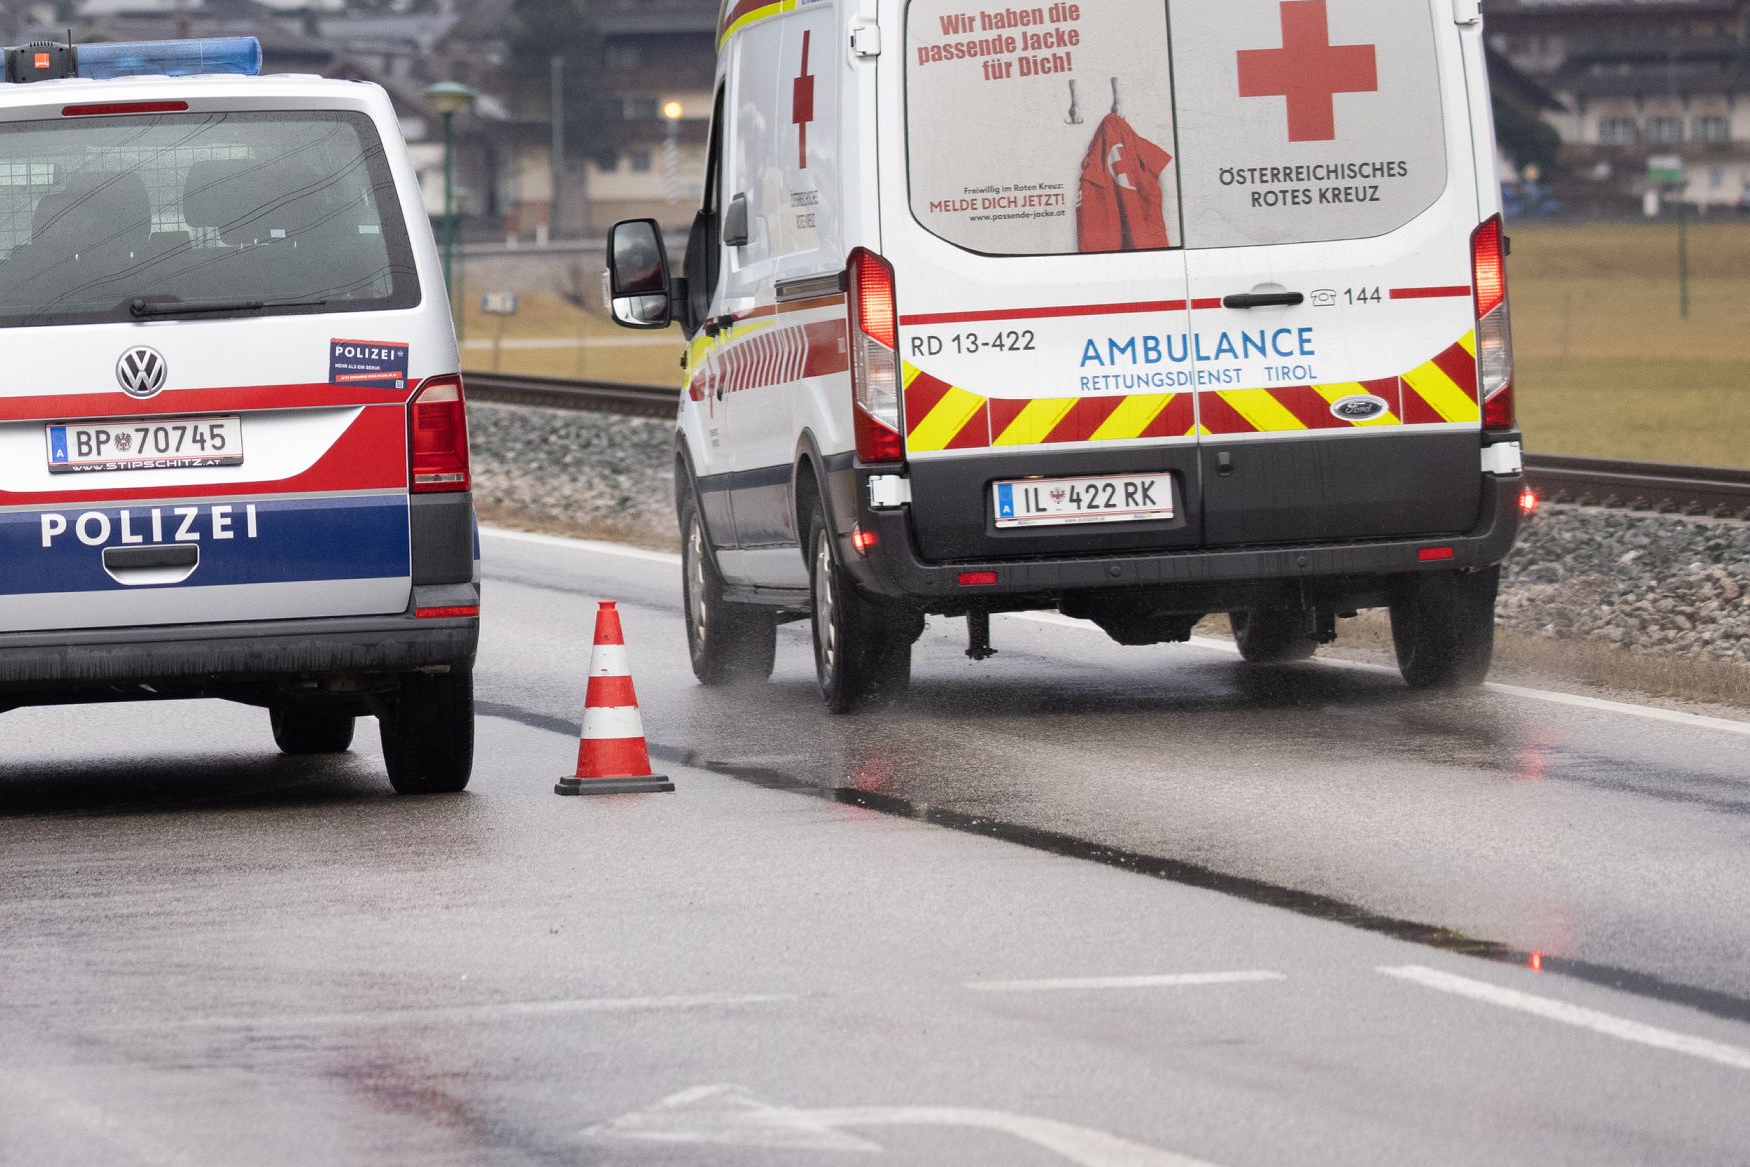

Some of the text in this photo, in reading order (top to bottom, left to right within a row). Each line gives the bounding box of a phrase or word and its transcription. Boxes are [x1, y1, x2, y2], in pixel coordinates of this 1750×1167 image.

[939, 1, 1081, 36] Wir haben die
[917, 27, 1080, 66] passende Jacke
[982, 51, 1073, 81] für Dich!
[1219, 160, 1408, 186] ÖSTERREICHISCHES
[964, 182, 1064, 195] Freiwillig im Roten Kreuz:
[1251, 185, 1380, 207] ROTES KREUZ
[930, 193, 1065, 213] MELDE DICH JETZT!
[969, 209, 1065, 222] www.passende-jacke.at
[1344, 286, 1382, 305] 144
[335, 346, 395, 360] POLIZEI
[911, 330, 1036, 356] RD 13-422
[1080, 327, 1315, 367] AMBULANCE
[1080, 364, 1318, 391] RETTUNGSDIENST TIROL
[56, 424, 226, 458] A BP 70745
[1002, 480, 1157, 513] A IL 422 RK
[41, 503, 258, 548] POLIZEI
